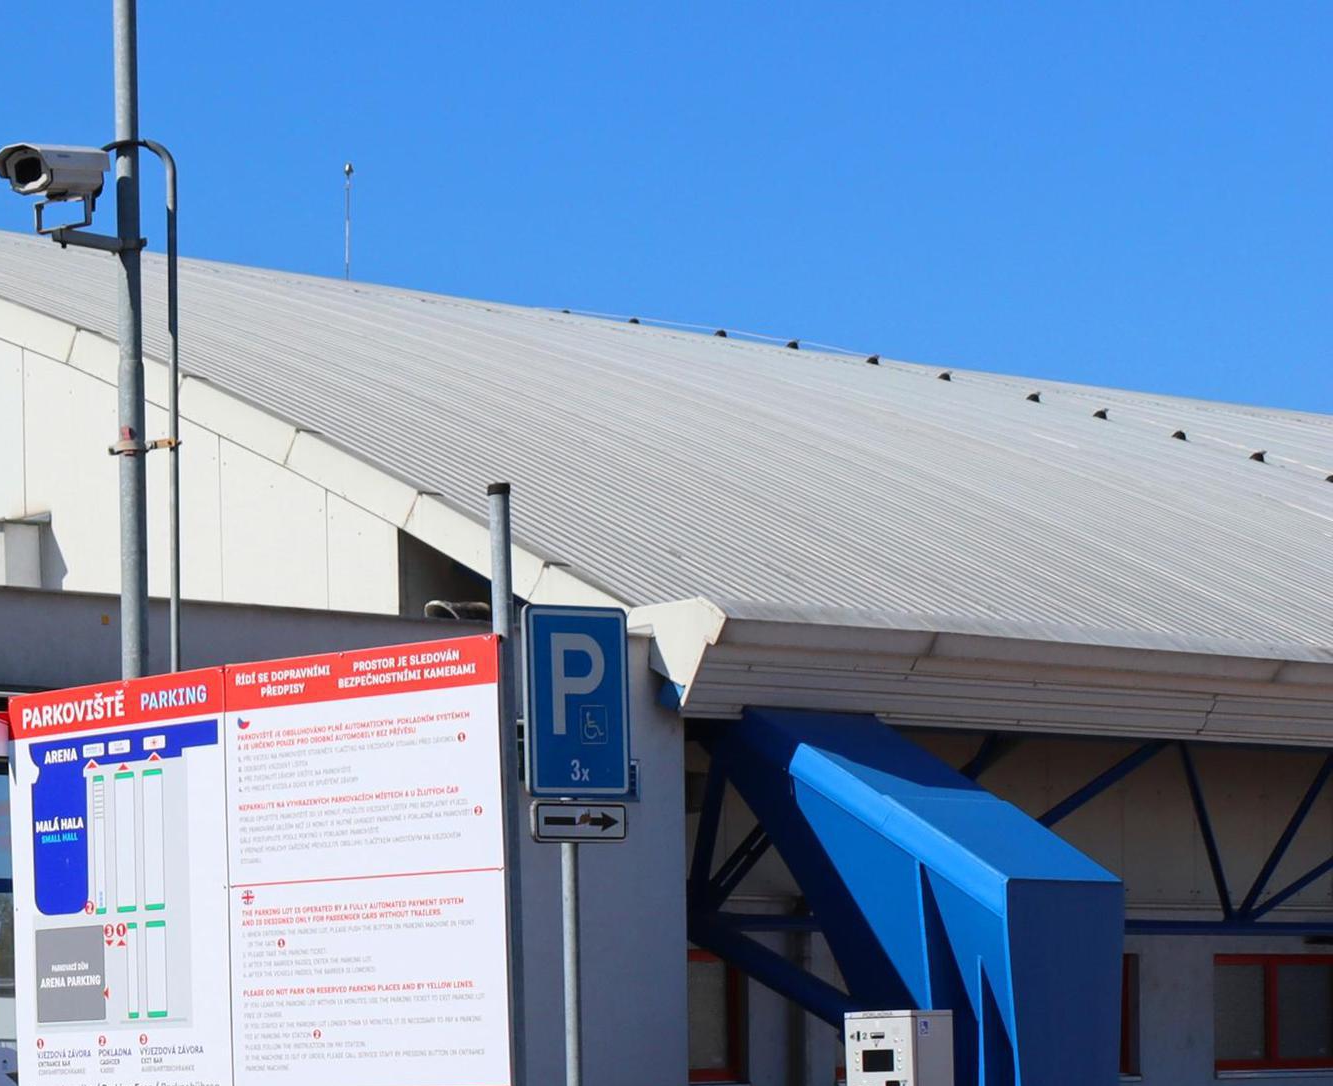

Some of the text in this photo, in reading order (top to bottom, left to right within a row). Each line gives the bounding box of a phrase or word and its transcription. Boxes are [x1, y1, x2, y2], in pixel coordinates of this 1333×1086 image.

[353, 649, 459, 672] PROSTOR JE SLEDOVÁN
[235, 664, 330, 686] ŘÍDÍ SE DOPRAVNÍMI
[338, 662, 475, 689] BEZPEČNOSTNÍMI KAMERAMI
[550, 632, 605, 735] P
[261, 682, 305, 697] PŘEDPISY
[22, 684, 207, 729] PARKOVIŠTĚ PARKING
[44, 747, 77, 765] ARENA
[571, 759, 590, 782] 3x
[35, 816, 84, 834] MALÁ HALA
[41, 831, 78, 844] SMALL HALL
[40, 974, 101, 989] ARENA PARKING
[348, 984, 375, 992] PARKING
[377, 983, 400, 991] PLACES
[37, 1049, 66, 1059] VJEZDOVÁ
[98, 1047, 131, 1056] POKLADNA
[139, 1045, 175, 1055] VÝJEZDOVÁ
